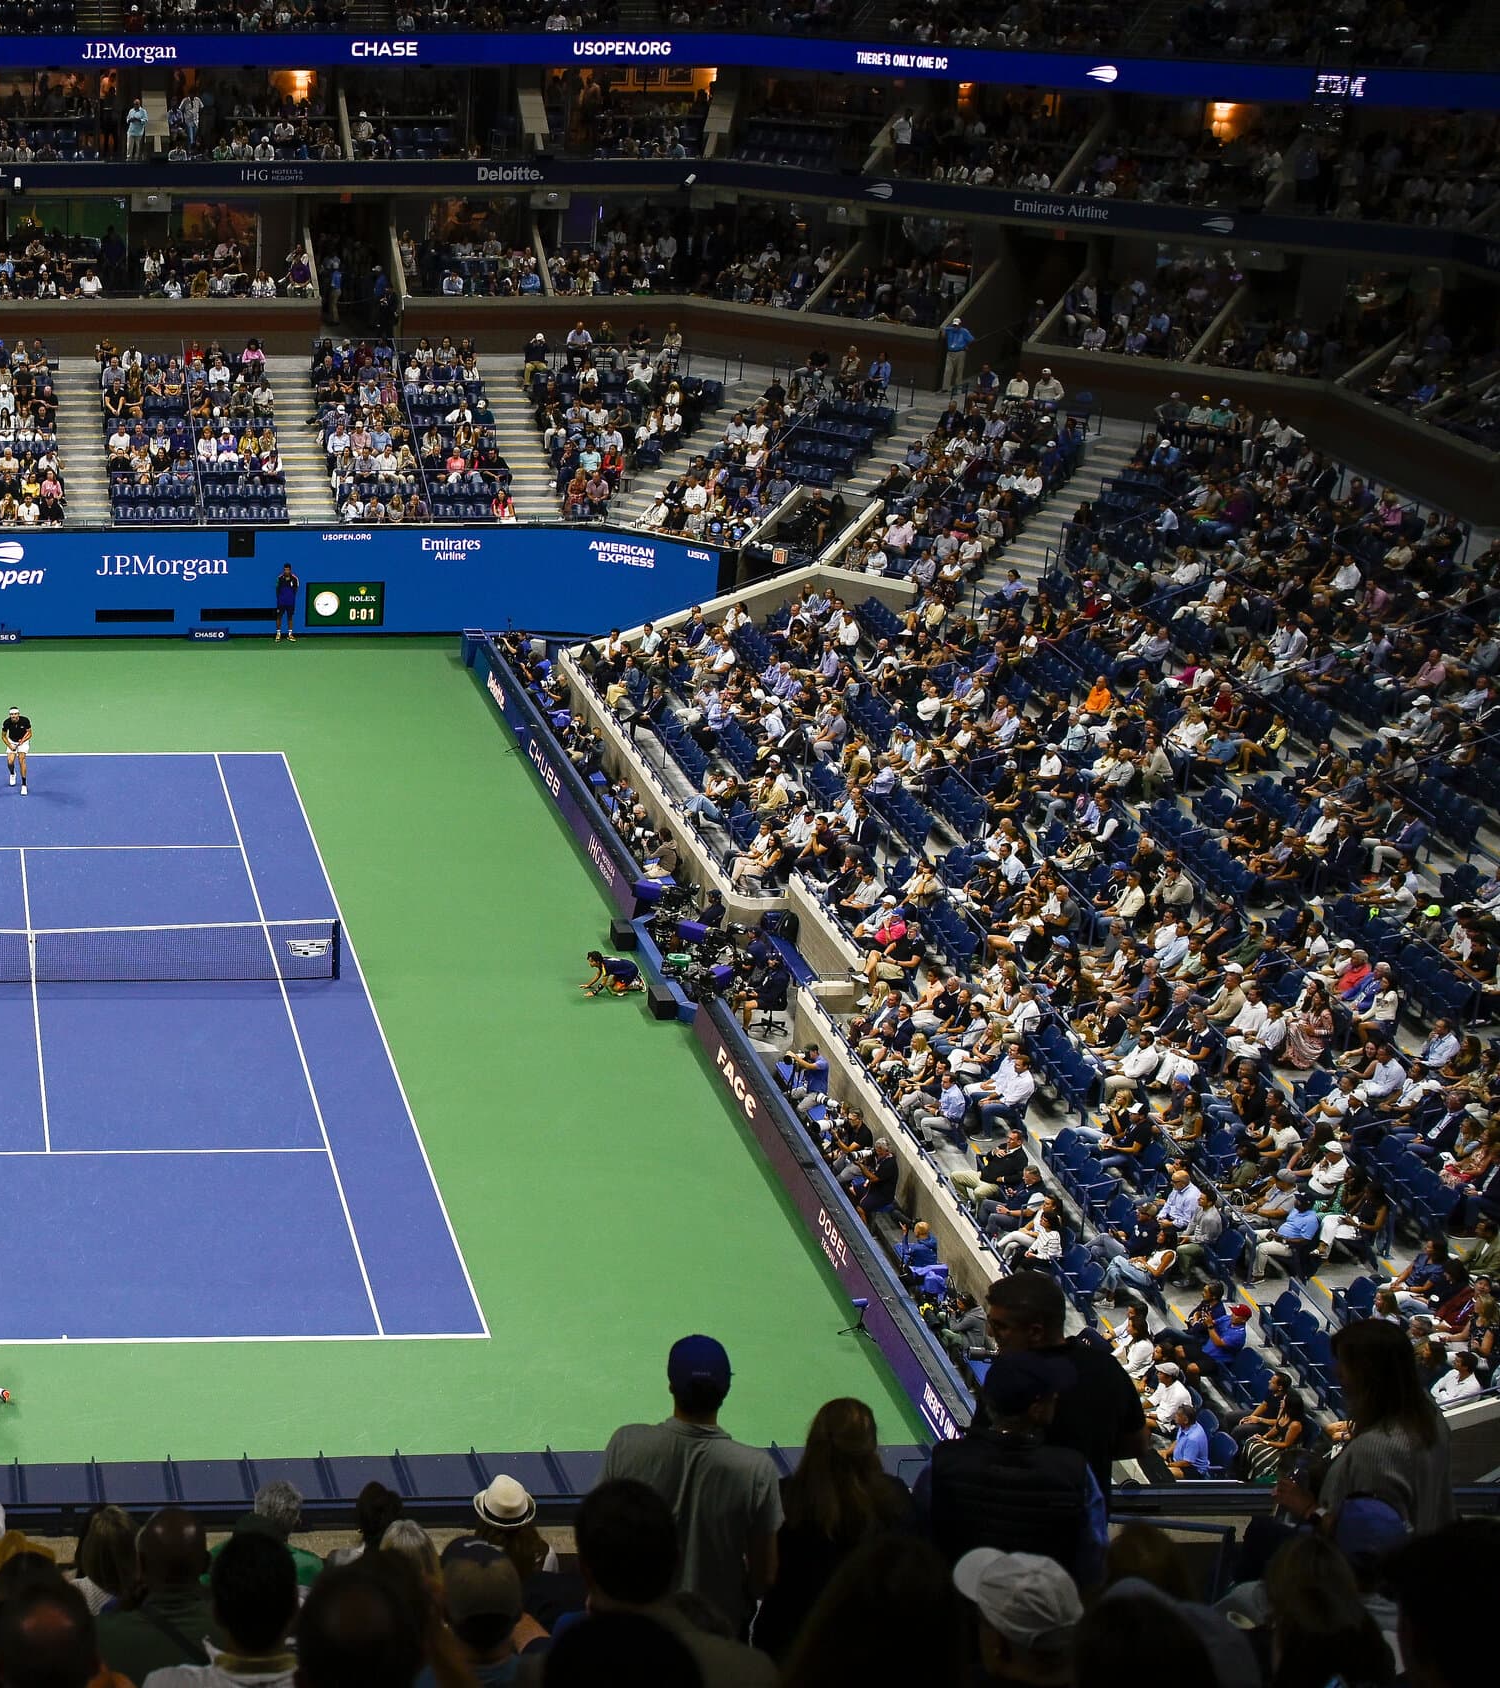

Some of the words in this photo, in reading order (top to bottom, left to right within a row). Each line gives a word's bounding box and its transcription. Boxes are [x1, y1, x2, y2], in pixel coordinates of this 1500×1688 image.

[81, 42, 177, 63] J.P.Morgan
[351, 42, 418, 57] CHASE
[573, 42, 672, 56] USOPEN.ORG
[856, 52, 891, 66] THERE'S
[892, 54, 916, 67] ONLY
[916, 56, 935, 69] ONE
[935, 57, 948, 70] DC
[241, 169, 268, 181] IHG
[477, 166, 544, 181] Deloitte.
[1013, 200, 1064, 217] Emirates
[1067, 204, 1109, 220] Airline
[322, 533, 372, 541] USOPEN.ORG
[421, 538, 481, 551] Emirates
[434, 550, 467, 561] Airline
[588, 541, 655, 559] AMERICAN
[687, 550, 710, 562] USTA
[597, 551, 655, 569] EXPRESS
[96, 555, 229, 582] J.P.Morgan
[349, 608, 374, 621] 0:01
[194, 631, 218, 639] CHASE
[528, 738, 561, 798] CHUBB
[716, 1045, 757, 1119] FAGE
[818, 1207, 848, 1267] DOBEL
